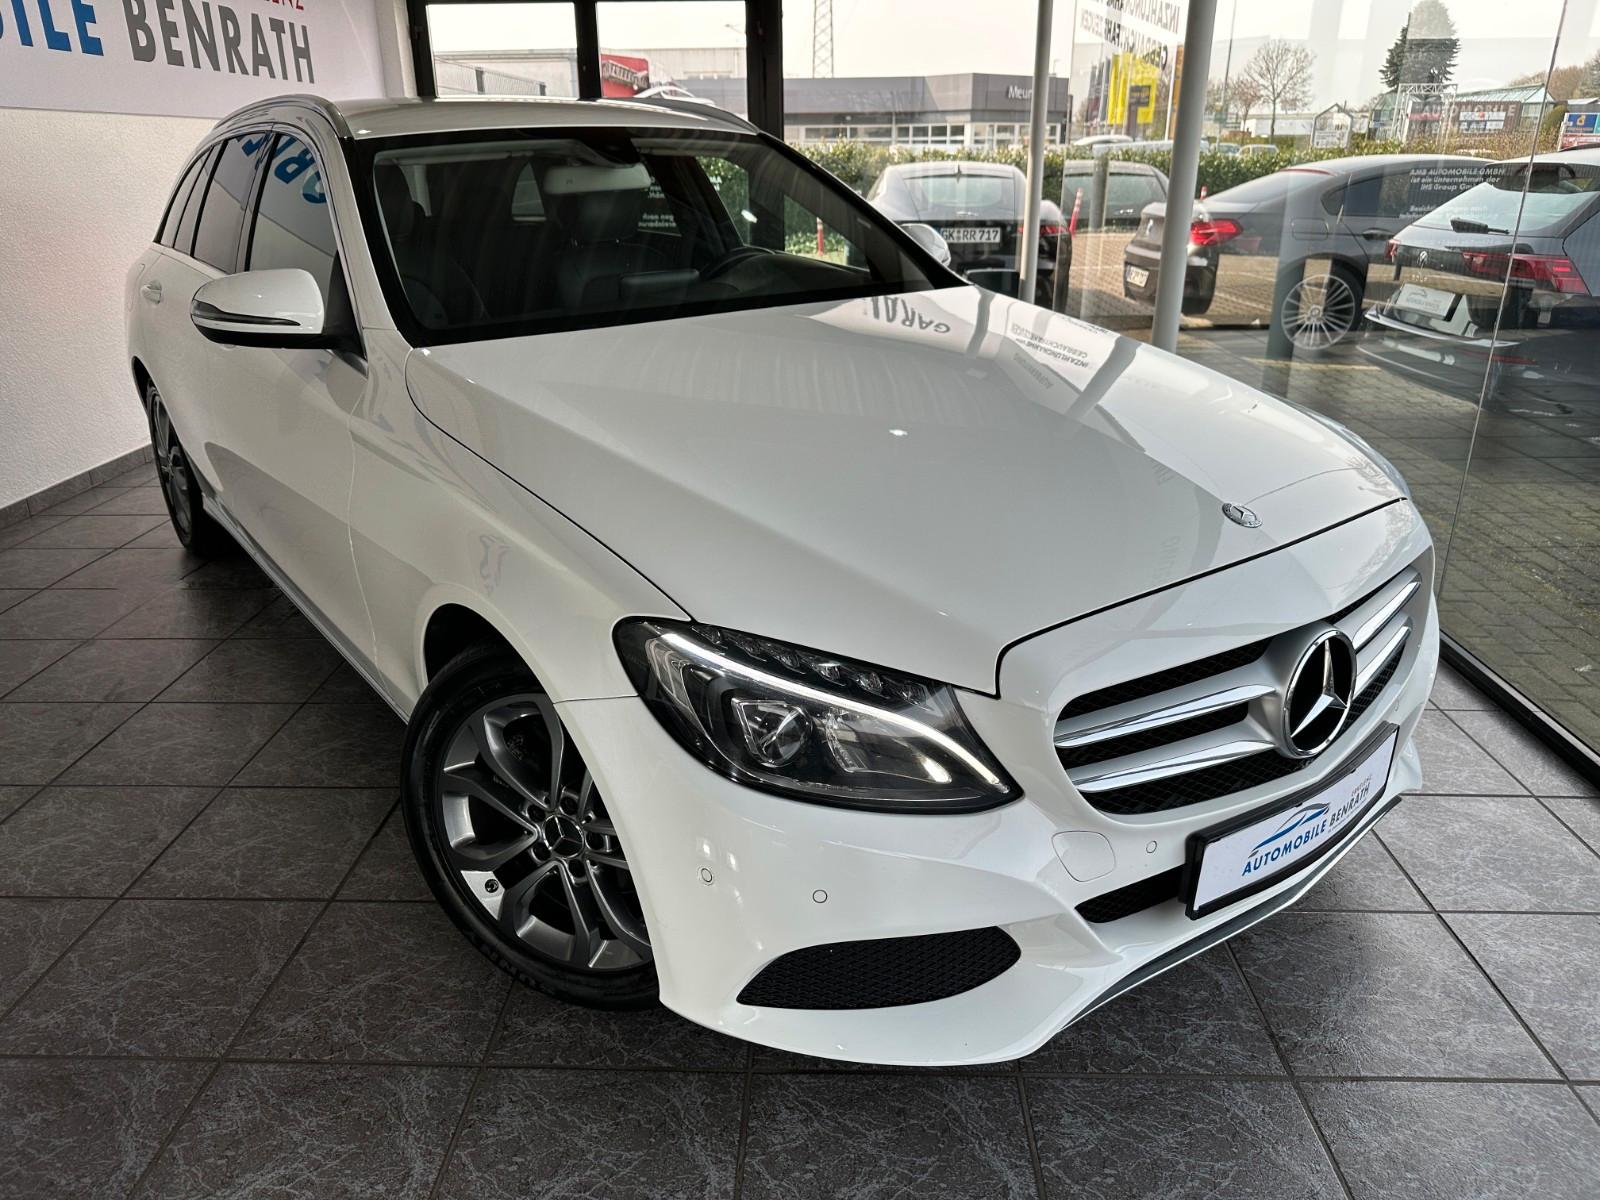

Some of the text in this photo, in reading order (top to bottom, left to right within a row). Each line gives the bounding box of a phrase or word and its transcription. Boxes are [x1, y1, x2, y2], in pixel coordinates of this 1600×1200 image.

[0, 0, 315, 84] ILE BENRATH
[962, 229, 976, 241] RR
[979, 229, 999, 241] 717
[1241, 819, 1328, 877] AUTOMOBILE
[1329, 782, 1371, 827] BENRATH
